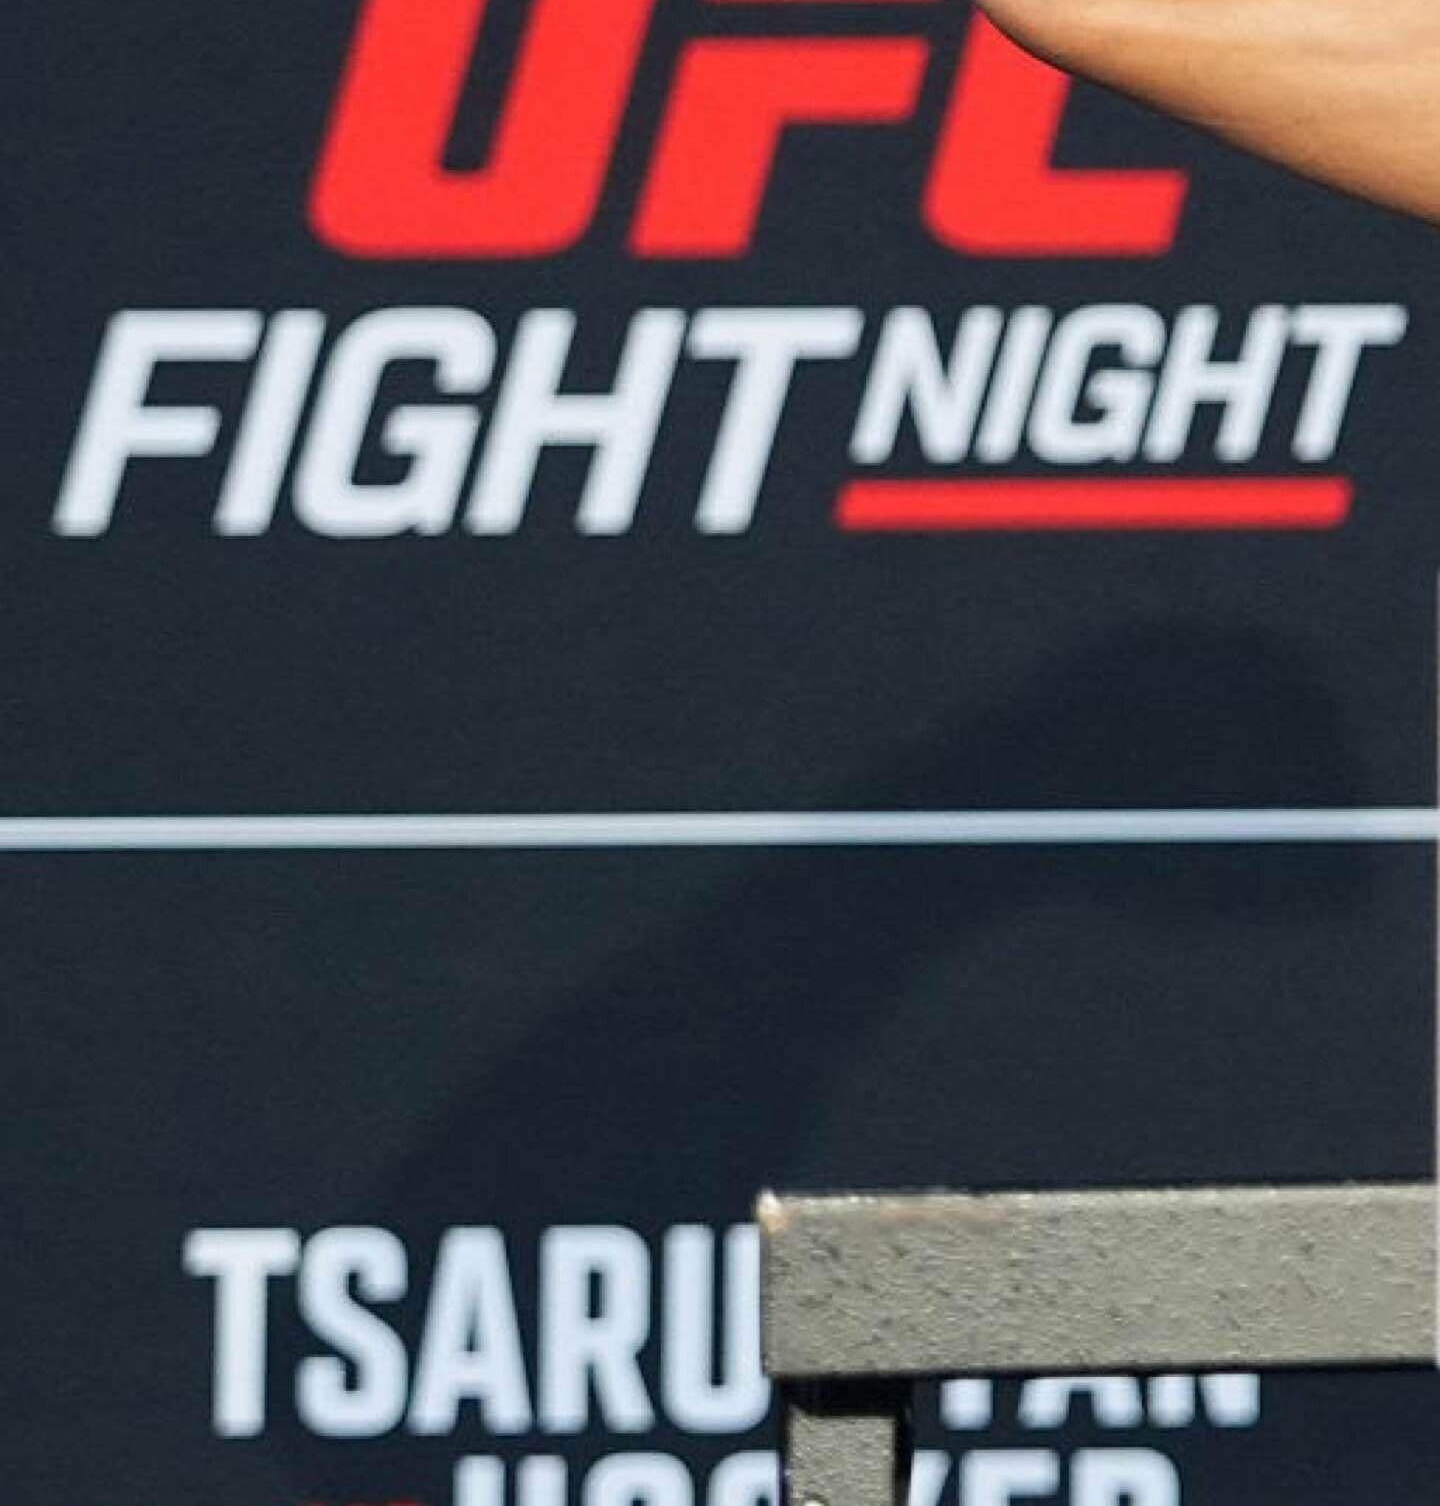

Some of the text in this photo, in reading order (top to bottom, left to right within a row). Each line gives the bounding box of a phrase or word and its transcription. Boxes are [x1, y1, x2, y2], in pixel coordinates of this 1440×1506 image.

[53, 304, 1407, 537] FIGHT NIGHT
[184, 1225, 1260, 1437] TSARU
